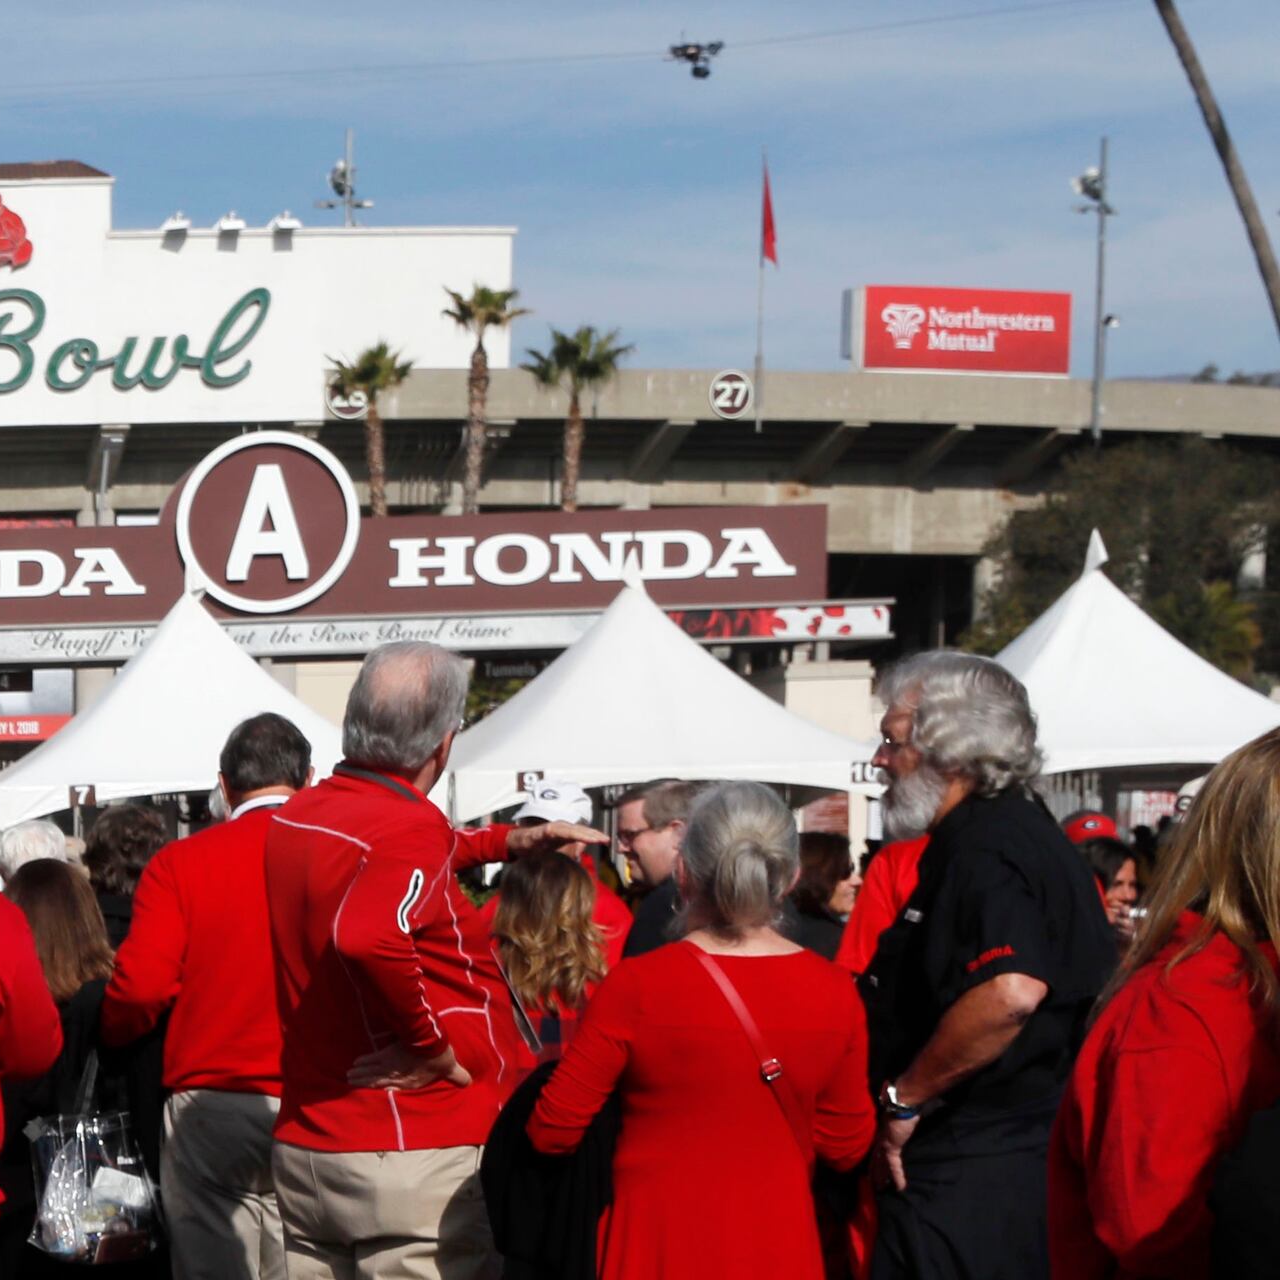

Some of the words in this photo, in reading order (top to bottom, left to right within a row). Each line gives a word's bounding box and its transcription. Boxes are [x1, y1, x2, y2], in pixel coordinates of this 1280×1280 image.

[928, 307, 1054, 332] Northwestern
[928, 330, 996, 352] Mutual
[714, 381, 748, 408] 27
[226, 464, 309, 581] A
[389, 527, 796, 587] HONDA
[30, 629, 120, 658] Playoff
[269, 622, 303, 644] the
[309, 623, 370, 644] Rose
[377, 620, 442, 641] Bowl
[450, 620, 513, 640] Game
[75, 786, 90, 804] 7
